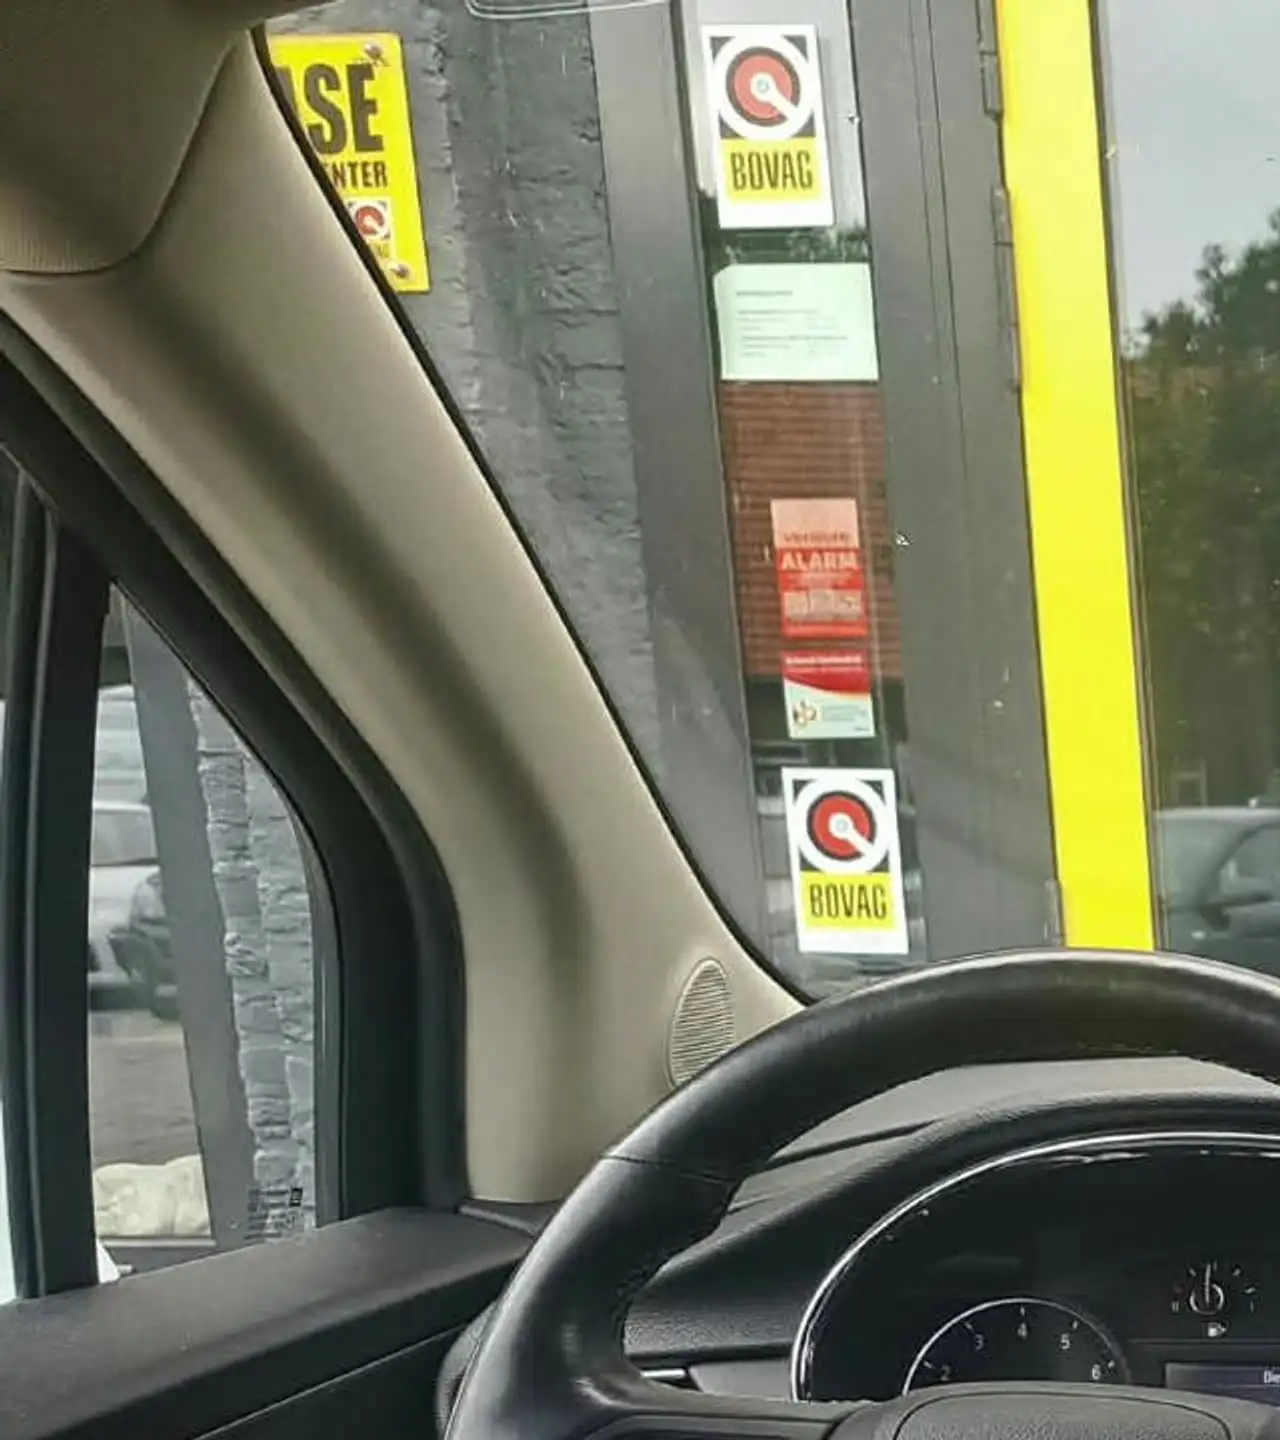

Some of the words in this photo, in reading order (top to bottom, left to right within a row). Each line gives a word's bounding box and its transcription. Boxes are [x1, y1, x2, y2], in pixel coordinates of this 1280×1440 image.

[325, 160, 388, 189] NTER
[730, 150, 813, 191] BOVAG
[809, 883, 887, 919] BOVAG
[1018, 1322, 1027, 1338] 4
[1060, 1334, 1071, 1350] 5
[1091, 1364, 1101, 1380] 6
